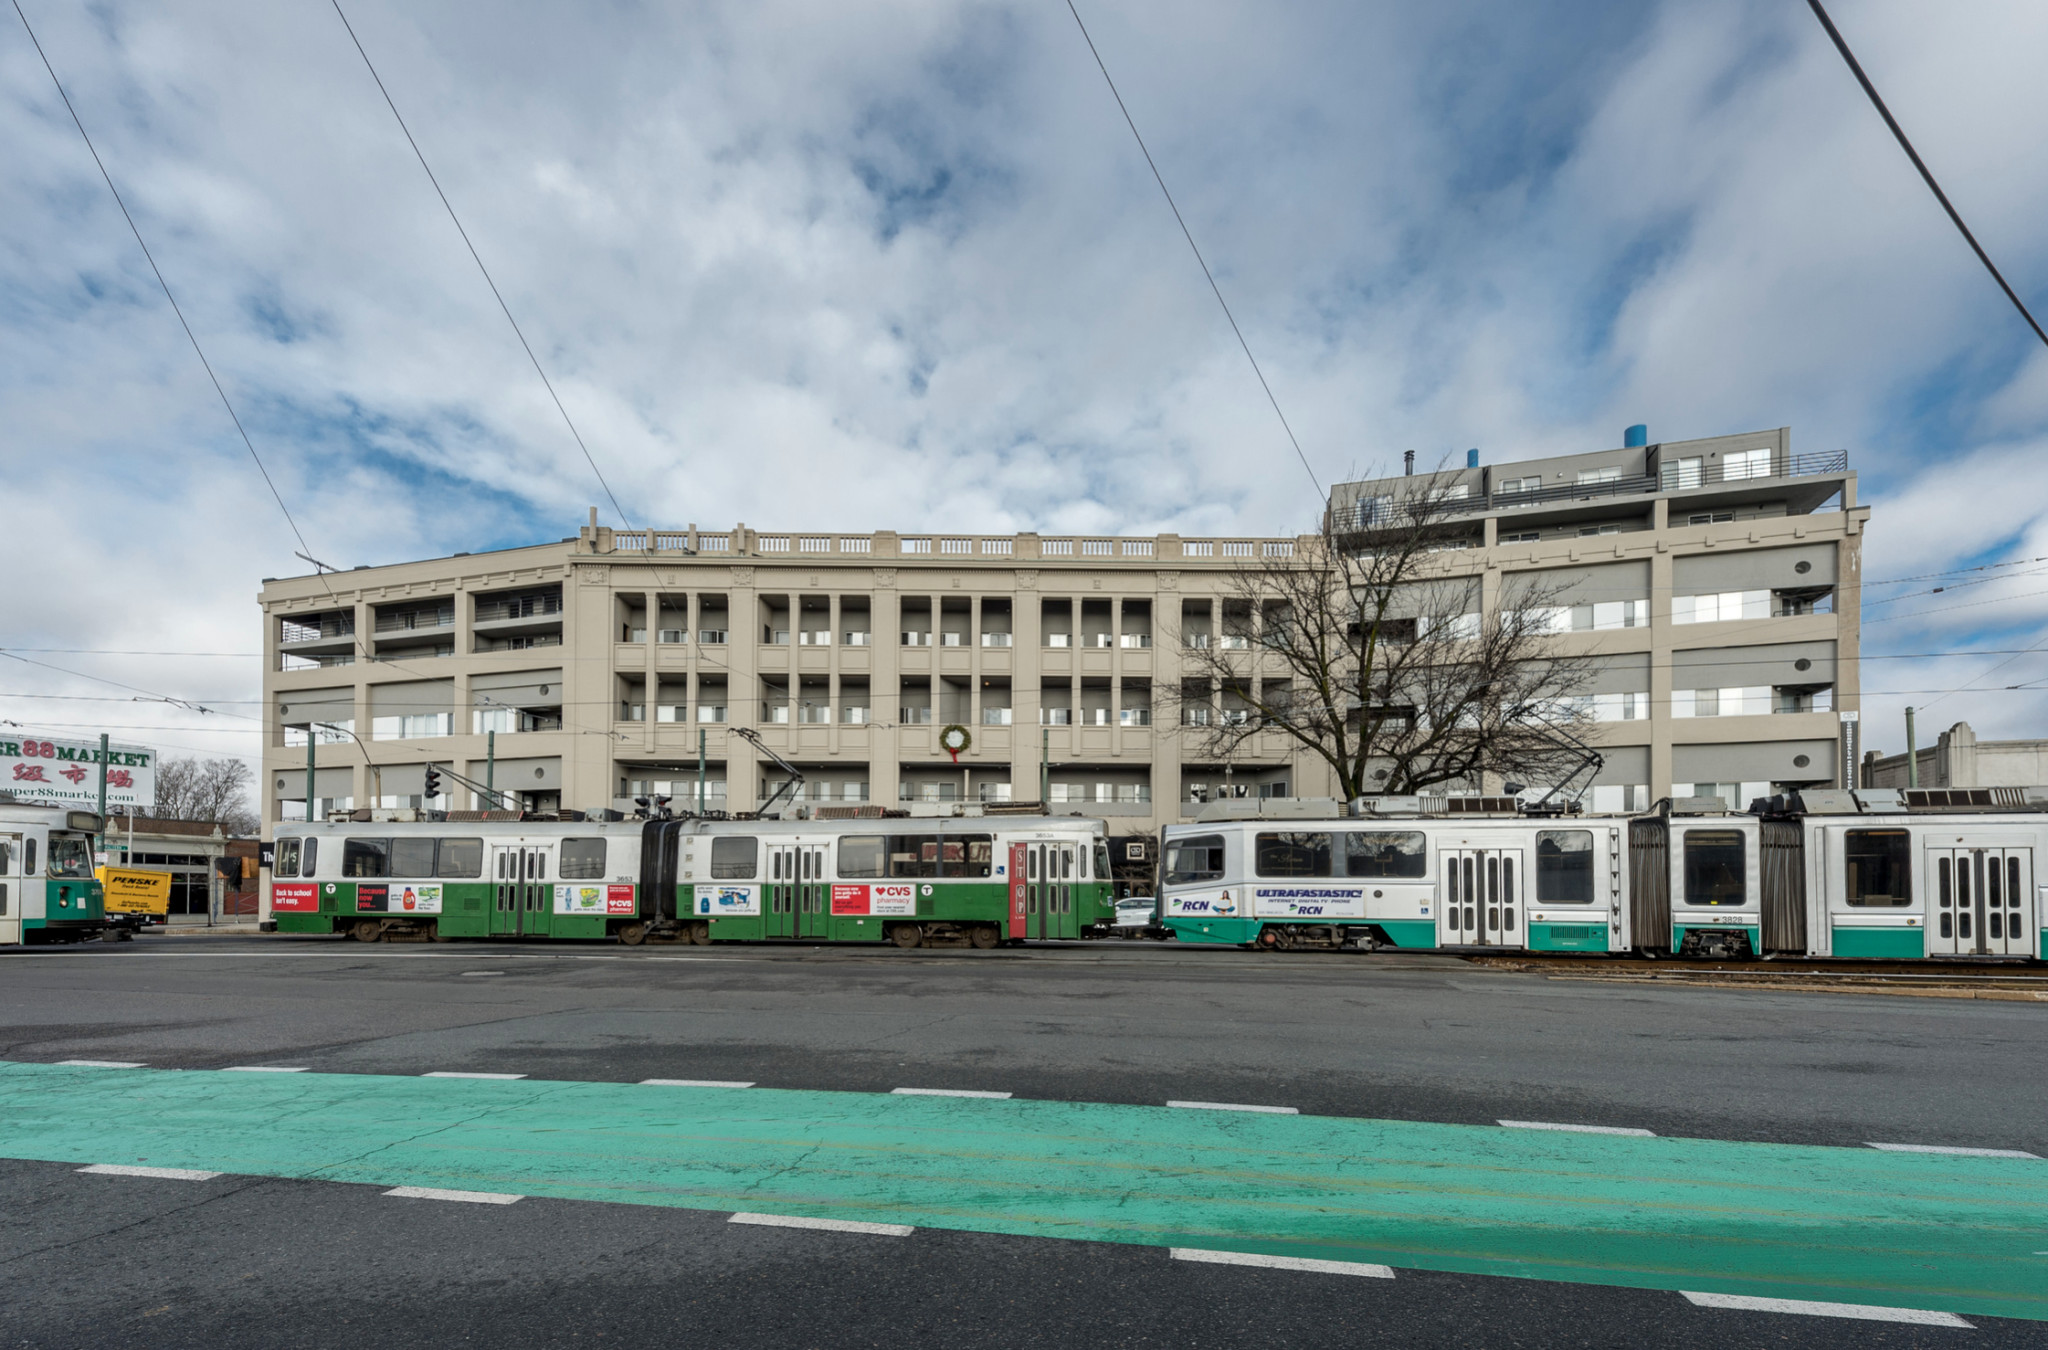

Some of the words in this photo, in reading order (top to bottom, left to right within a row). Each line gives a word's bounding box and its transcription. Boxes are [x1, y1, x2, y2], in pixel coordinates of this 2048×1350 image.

[22, 739, 55, 759] 88
[112, 876, 161, 886] PENSKE
[275, 889, 287, 897] Back
[293, 889, 312, 897] school
[358, 887, 387, 895] Because
[886, 886, 911, 896] CVS
[1255, 889, 1364, 898] ULTRAFASTASTIC!
[876, 897, 911, 905] pharmacy
[1182, 900, 1210, 911] RCN
[1297, 906, 1324, 915] RCN
[1722, 915, 1743, 924] 3828
